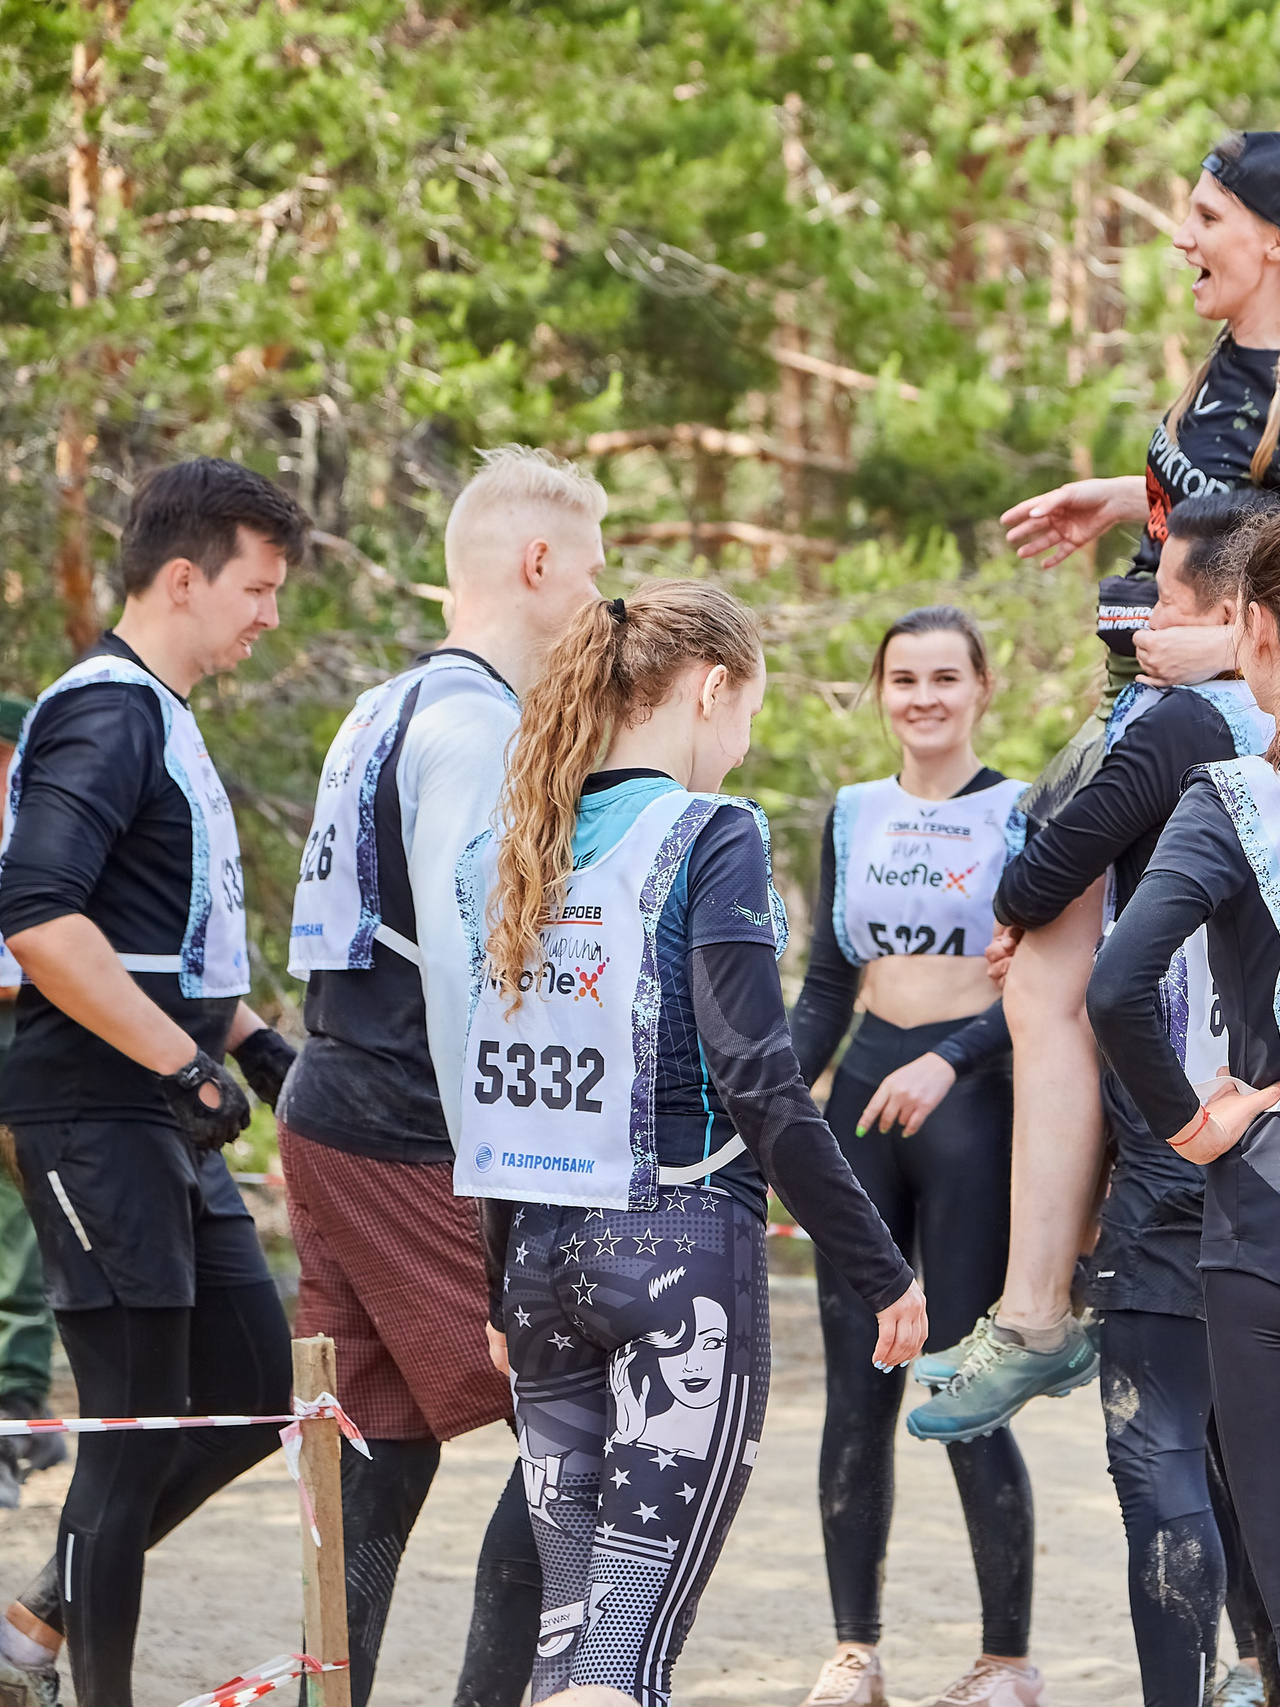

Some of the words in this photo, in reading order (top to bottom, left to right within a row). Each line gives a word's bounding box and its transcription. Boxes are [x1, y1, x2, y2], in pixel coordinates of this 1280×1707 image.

[866, 861, 981, 899] Neoflex
[473, 1040, 605, 1113] 5332
[501, 1152, 596, 1174] ГАЗПРОМБАНК
